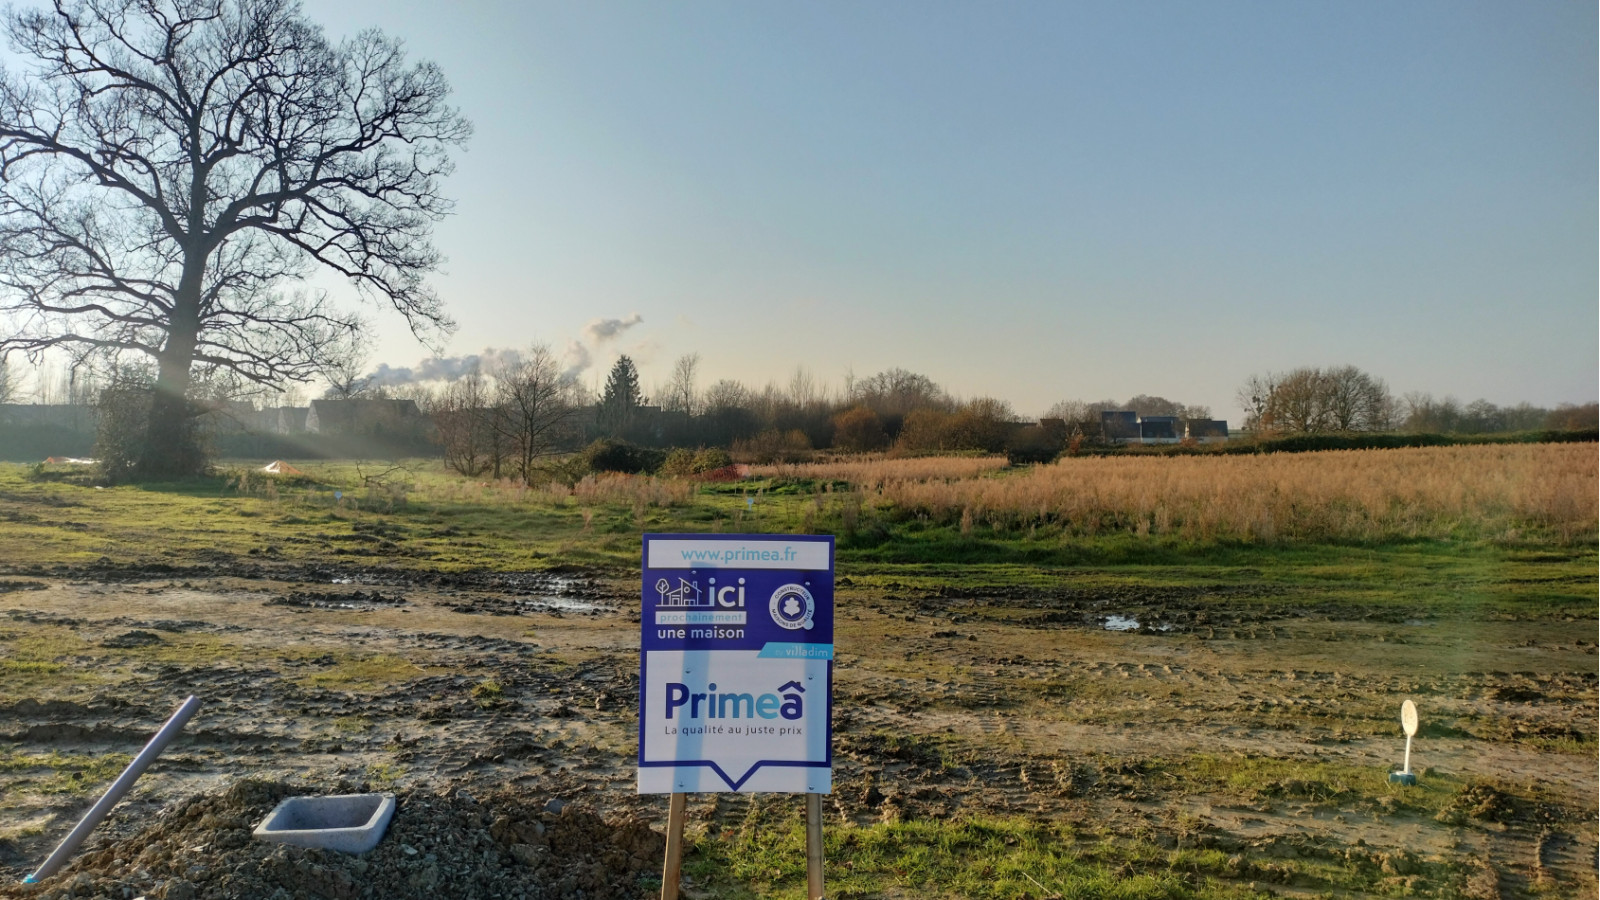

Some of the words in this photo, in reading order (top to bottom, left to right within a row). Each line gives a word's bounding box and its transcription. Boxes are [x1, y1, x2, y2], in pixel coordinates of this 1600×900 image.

[681, 546, 798, 564] www.primea.fr
[708, 577, 746, 608] ici
[660, 613, 742, 624] prochainement
[657, 629, 686, 639] une
[691, 626, 744, 639] maison
[785, 646, 828, 657] villadim
[665, 726, 677, 735] La
[682, 725, 724, 736] qualité
[728, 727, 742, 735] au
[745, 726, 775, 736] juste
[779, 726, 802, 736] prix
